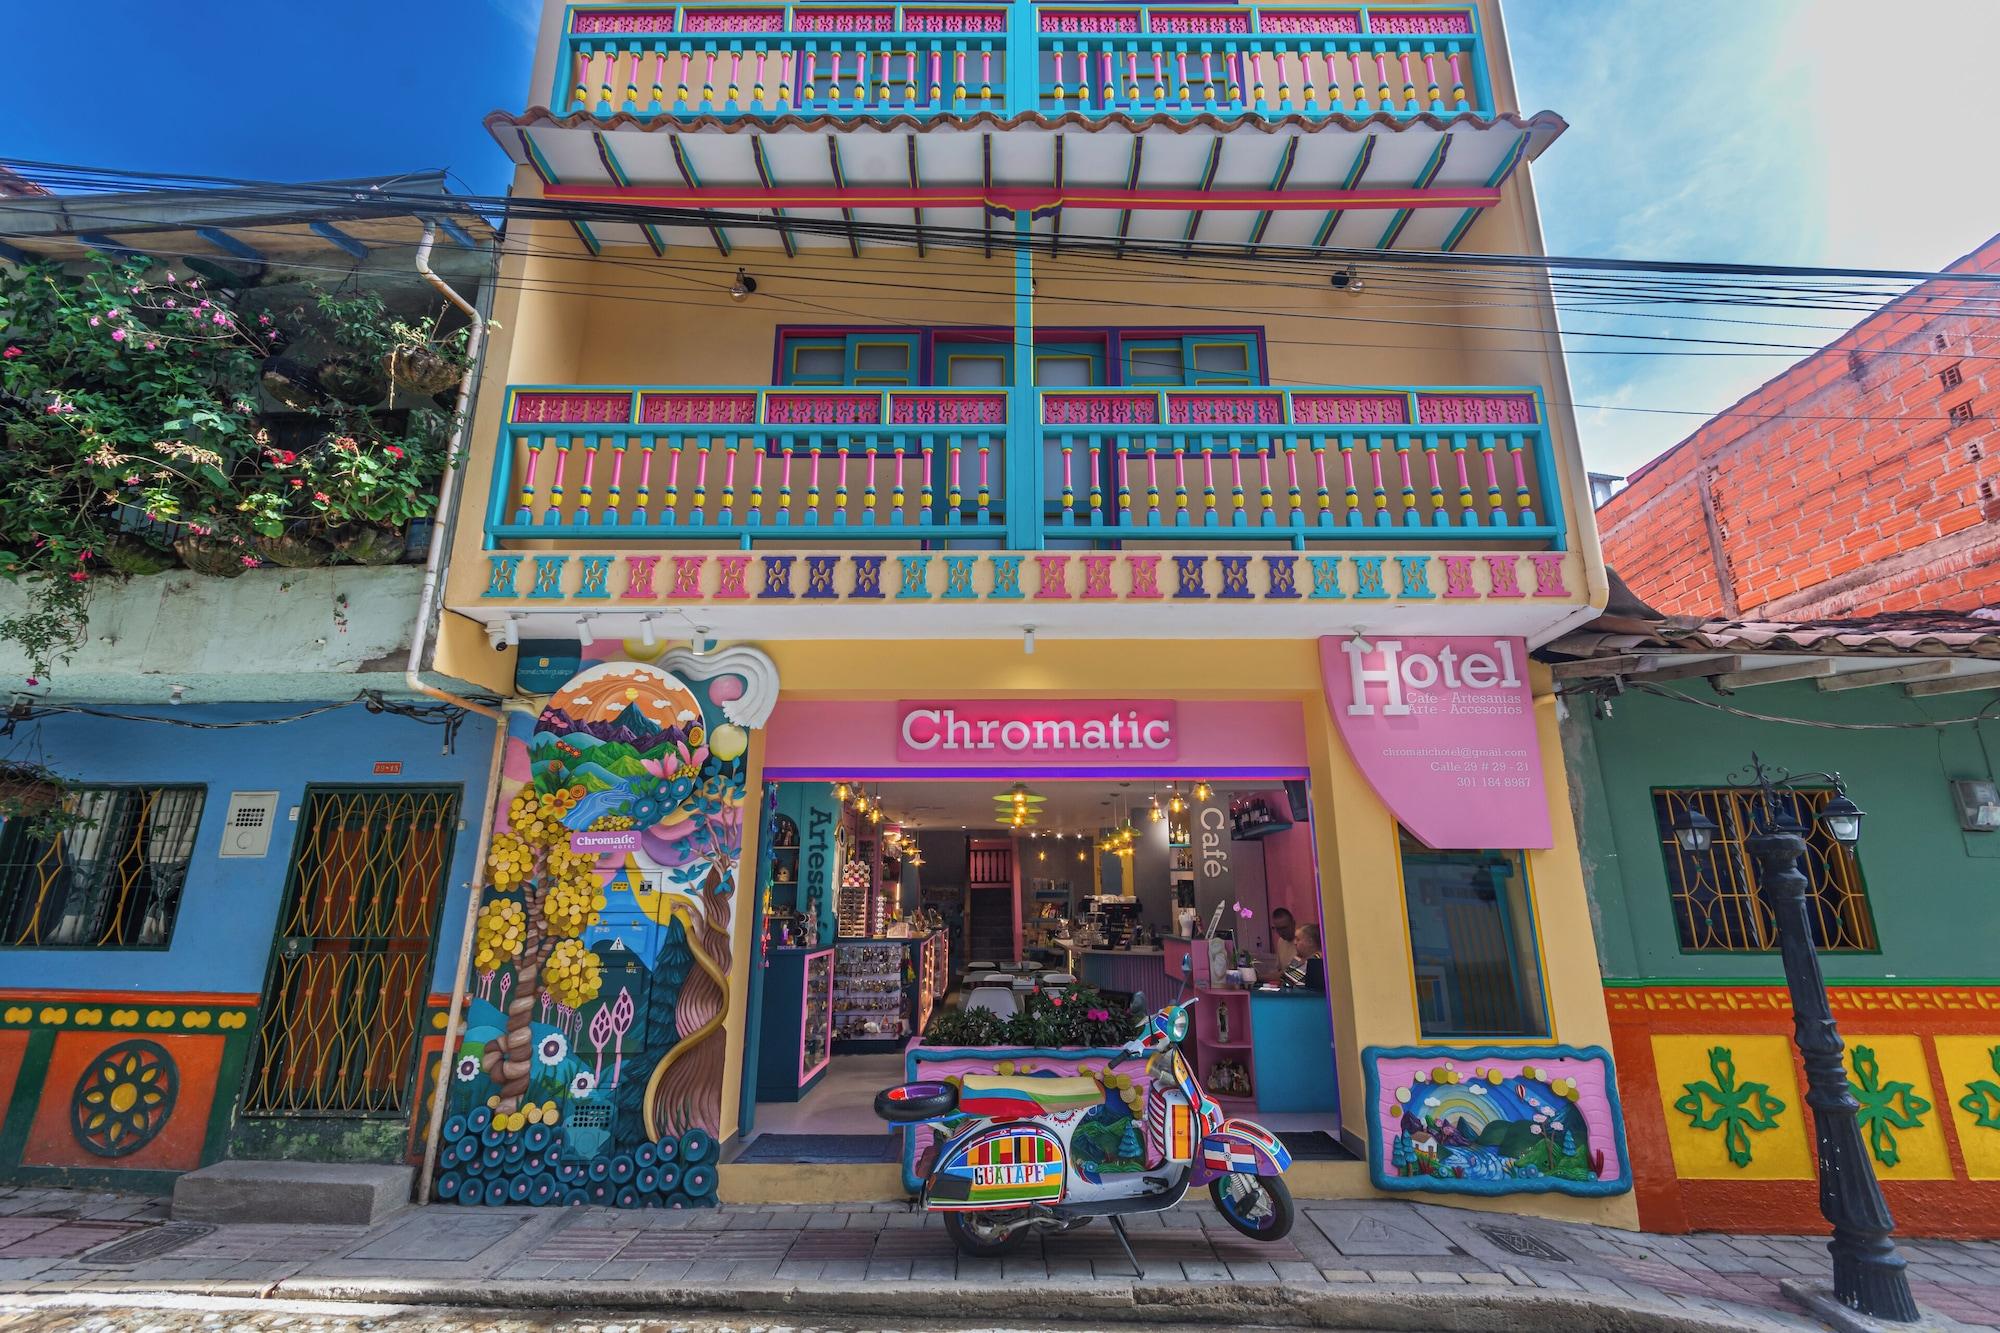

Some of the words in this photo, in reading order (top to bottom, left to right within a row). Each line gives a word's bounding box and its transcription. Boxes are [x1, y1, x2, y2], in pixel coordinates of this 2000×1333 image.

[1341, 640, 1522, 716] Hotel
[1408, 703, 1438, 715] Arte
[1450, 703, 1523, 715] Accesorios
[902, 709, 1171, 750] Chromatic
[1382, 747, 1528, 759] chromatichotel@gmail.com
[1430, 761, 1462, 772] Calle
[1463, 761, 1478, 772] 29
[1492, 761, 1506, 772] 29
[576, 834, 636, 846] Chromatic
[1200, 807, 1229, 878] Café
